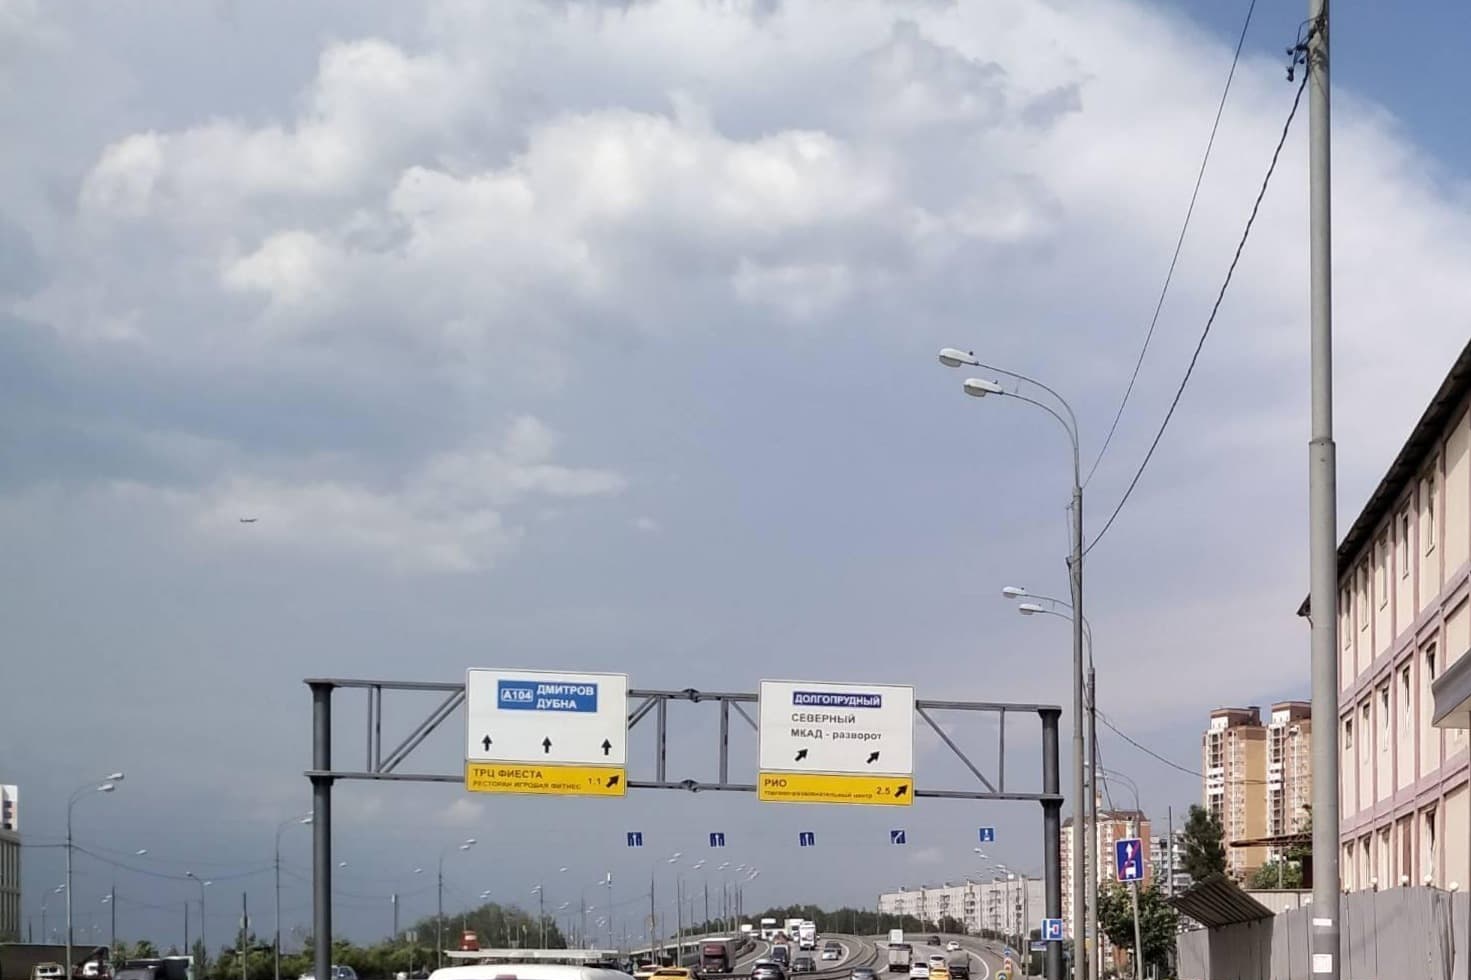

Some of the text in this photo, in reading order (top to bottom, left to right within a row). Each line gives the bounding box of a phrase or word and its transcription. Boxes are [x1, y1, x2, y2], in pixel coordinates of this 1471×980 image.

[536, 684, 594, 696] ДМИТРОВ
[536, 698, 577, 709] ДУБНА
[794, 693, 880, 706] ДОЛГОПРУДНЫЙ
[791, 713, 856, 724] СЕВЕРНЫЙ
[791, 728, 823, 740] МКАД
[832, 731, 882, 741] разворот
[473, 768, 543, 779] ТРЦ ФИЕСТА
[764, 779, 788, 788] РИО
[876, 786, 891, 795] 2.5
